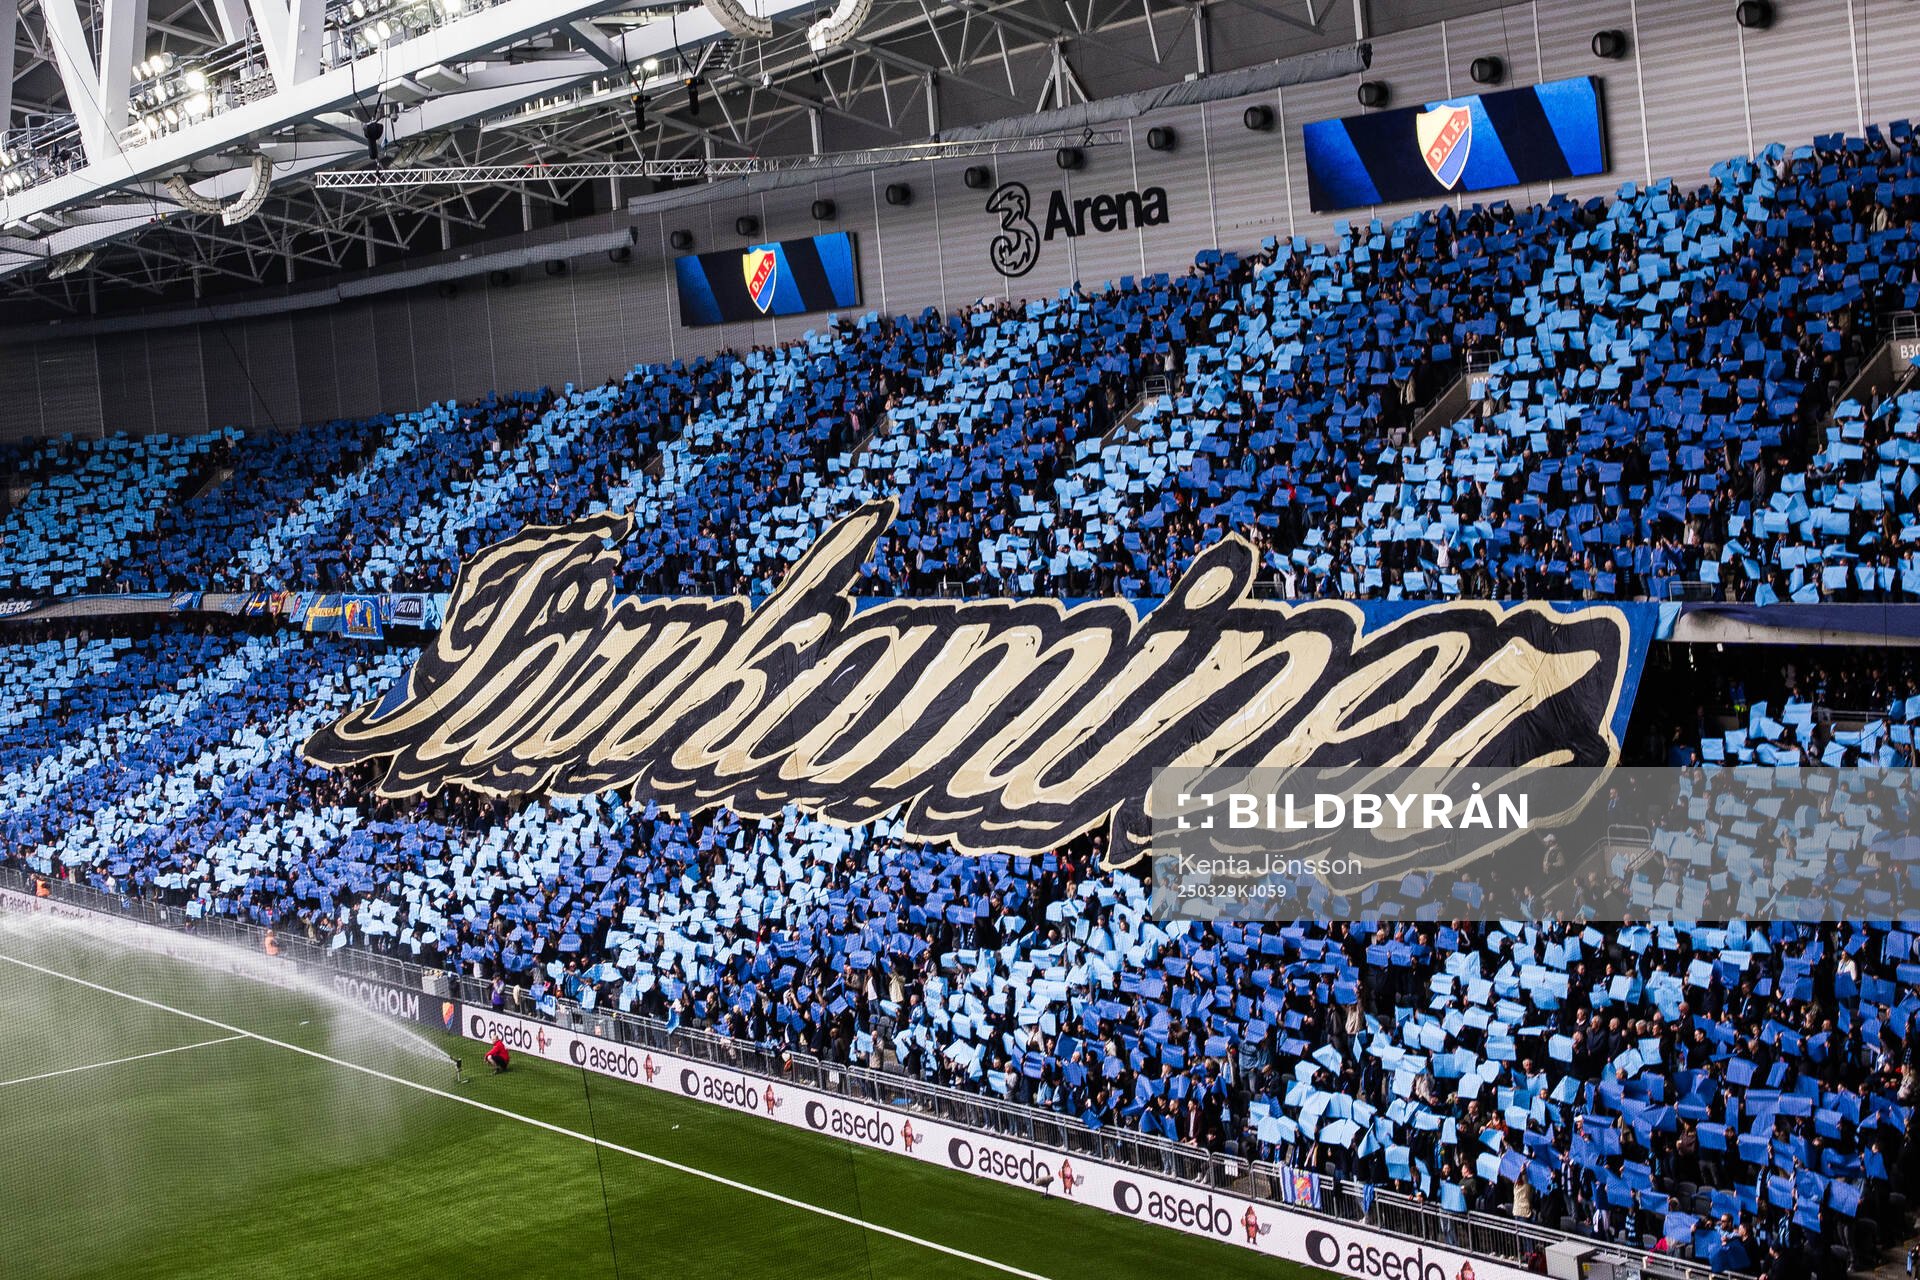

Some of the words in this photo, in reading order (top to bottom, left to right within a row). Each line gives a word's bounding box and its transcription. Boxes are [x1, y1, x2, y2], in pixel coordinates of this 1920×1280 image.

[1430, 118, 1465, 164] D.I.F.
[1044, 186, 1170, 241] Arena
[334, 975, 419, 1020] STOCKHOLM
[488, 1020, 532, 1050] asedo
[590, 1045, 638, 1079] asedo
[703, 1077, 758, 1110] asedo
[832, 1108, 894, 1146] asedo
[978, 1147, 1050, 1184] asedo
[1148, 1191, 1232, 1236] asedo
